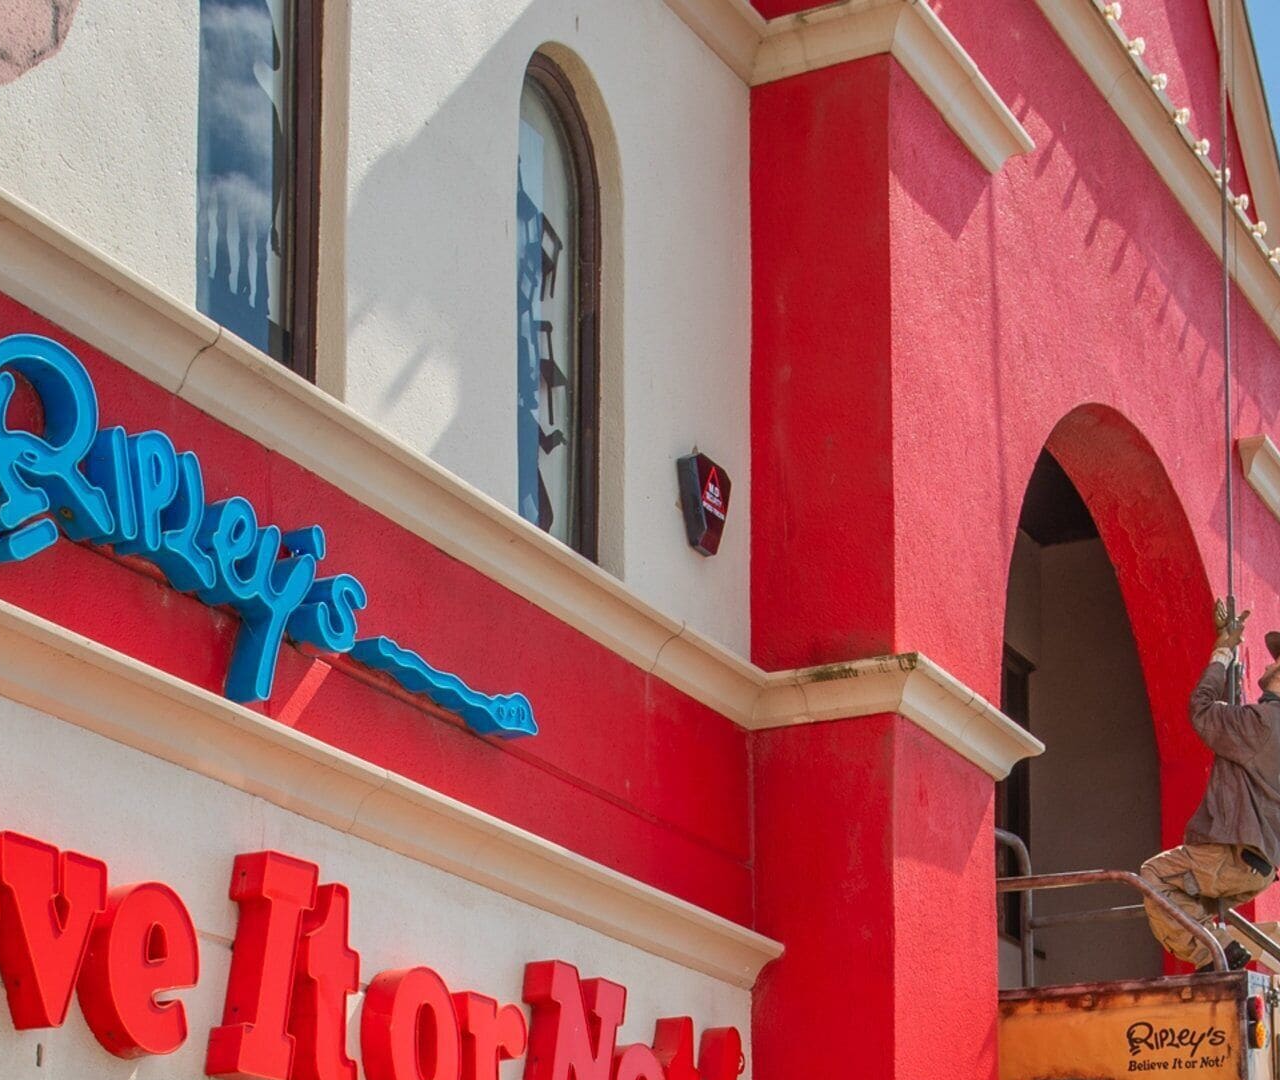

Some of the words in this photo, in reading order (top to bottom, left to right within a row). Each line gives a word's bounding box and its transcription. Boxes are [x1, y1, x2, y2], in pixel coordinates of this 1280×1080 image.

[1126, 1021, 1226, 1057] Ripley's
[1128, 1060, 1169, 1072] Believe
[1172, 1058, 1182, 1069] It
[1185, 1061, 1197, 1069] or
[1200, 1055, 1225, 1068] Not!
